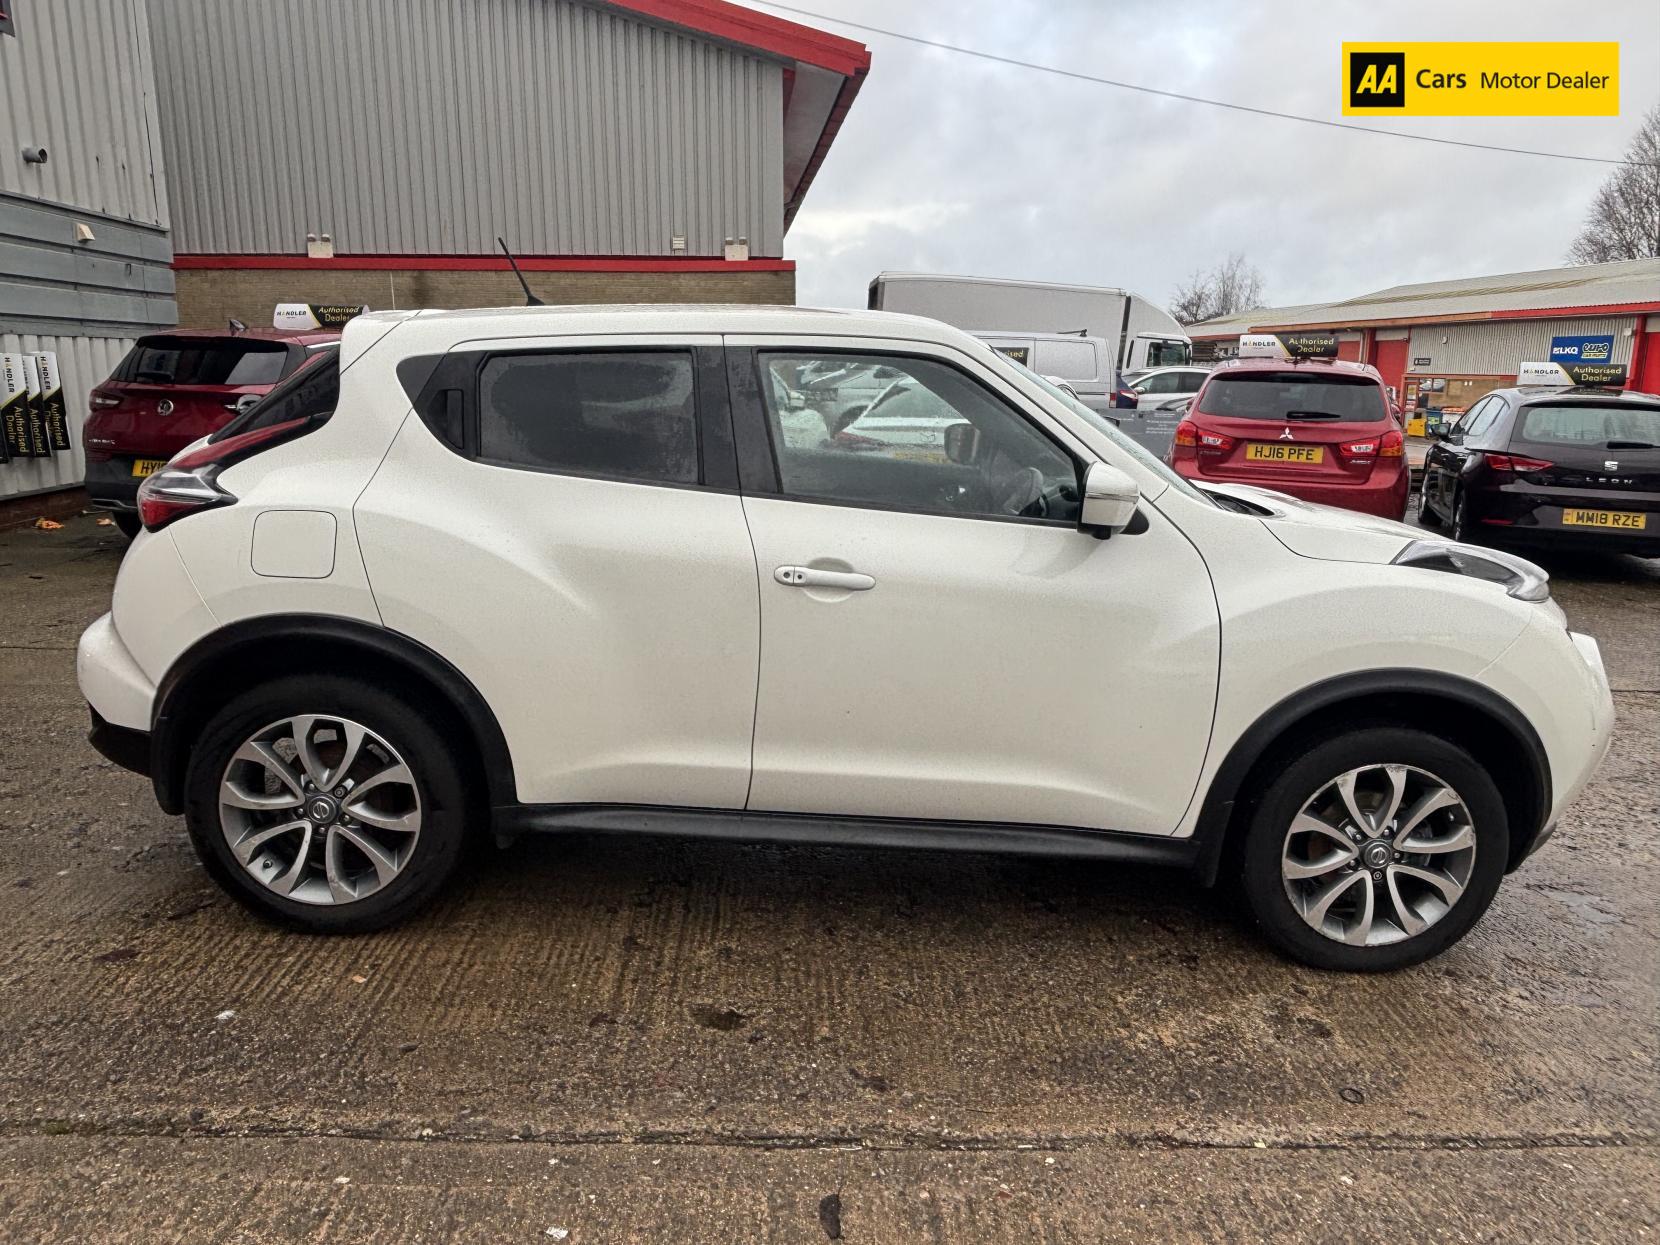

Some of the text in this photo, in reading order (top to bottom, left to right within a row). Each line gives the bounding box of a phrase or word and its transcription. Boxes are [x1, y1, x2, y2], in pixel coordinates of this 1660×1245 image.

[1560, 346, 1579, 354] LKQ
[1573, 366, 1622, 374] Authorised
[1581, 373, 1612, 381] Dealer
[14, 406, 30, 453] Authorised
[50, 402, 66, 446] Authorised
[1254, 446, 1315, 461] HJ16 PFE
[1575, 511, 1641, 528] MM18 RZE
